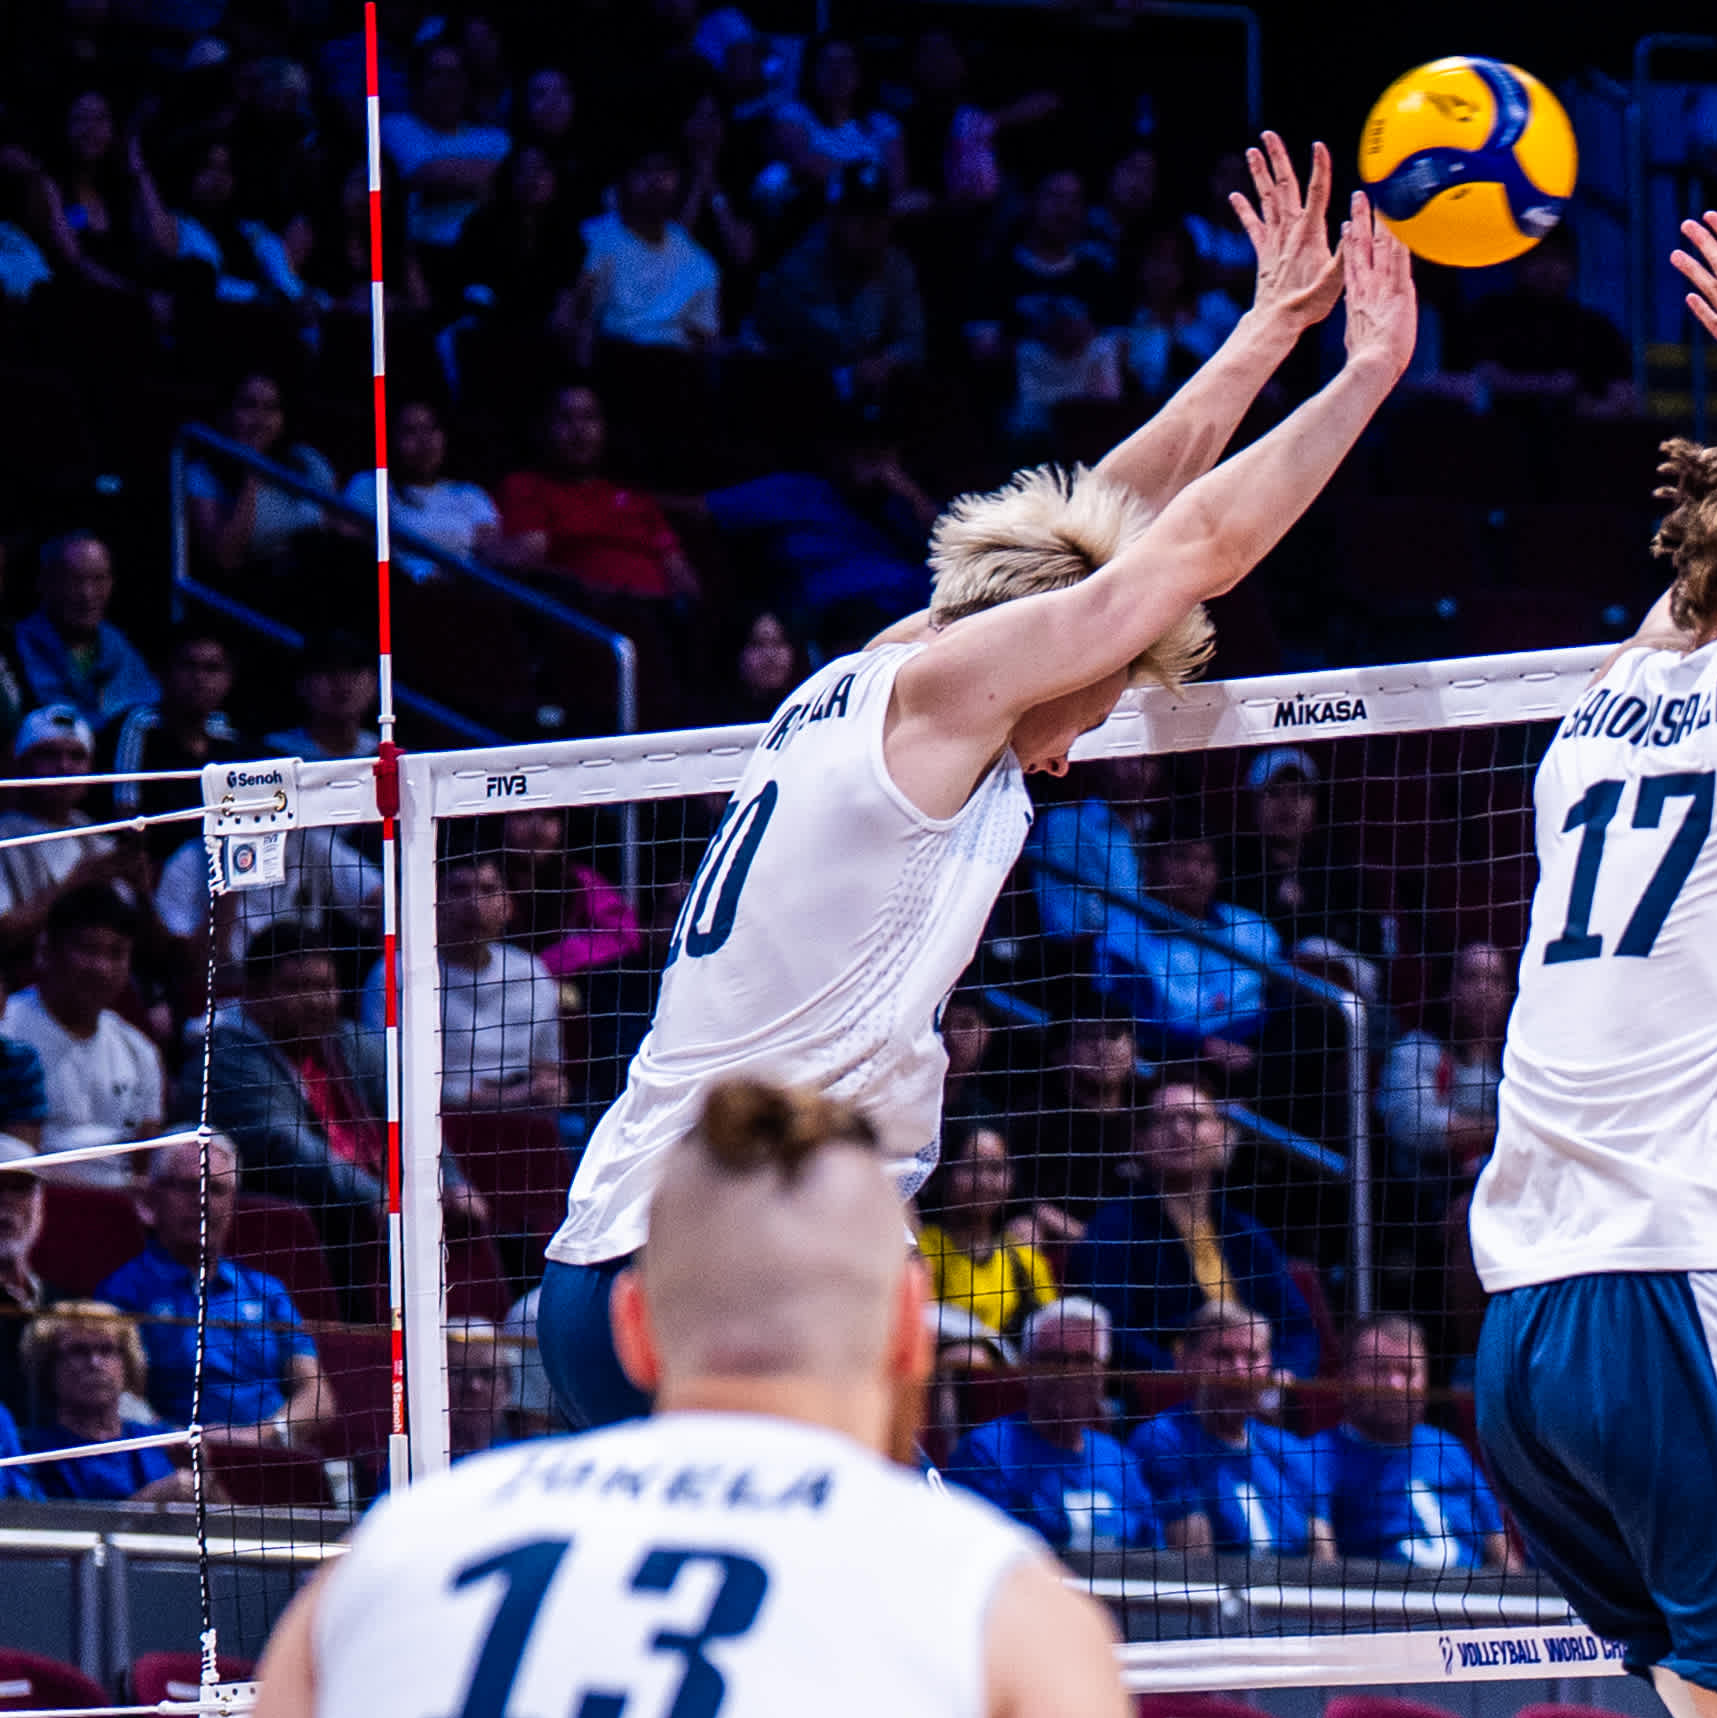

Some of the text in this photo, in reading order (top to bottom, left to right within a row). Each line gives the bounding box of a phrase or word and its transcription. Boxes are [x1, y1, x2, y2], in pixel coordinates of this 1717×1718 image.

[1273, 694, 1368, 728] MIKASA
[237, 769, 283, 788] Senoh
[1543, 770, 1717, 965] 17
[1457, 1638, 1542, 1668] VOLLEYBALL
[1543, 1635, 1599, 1663] WORLD
